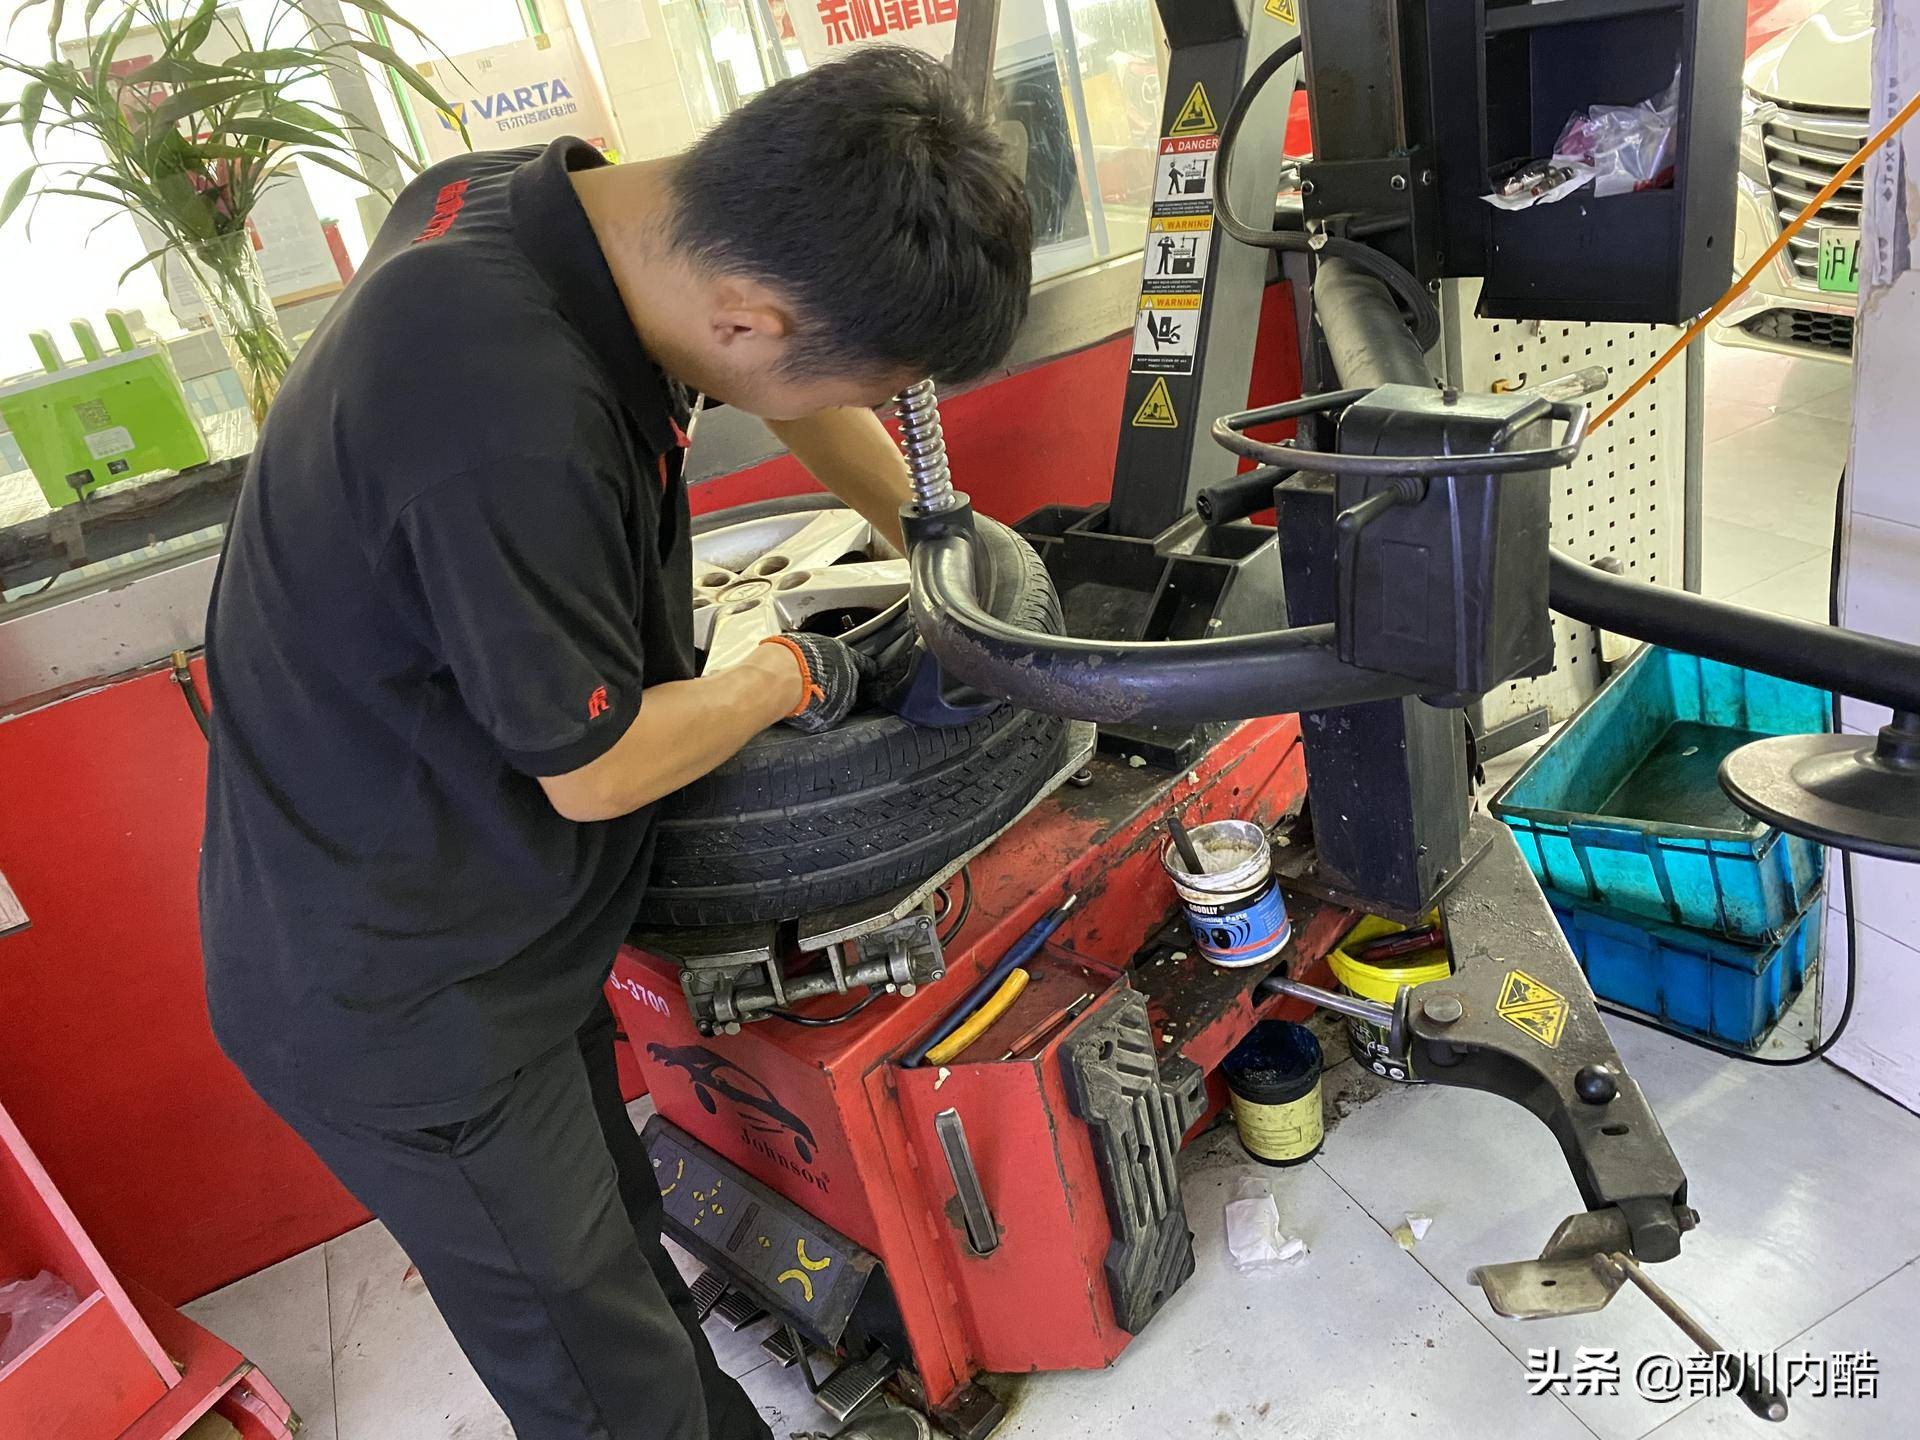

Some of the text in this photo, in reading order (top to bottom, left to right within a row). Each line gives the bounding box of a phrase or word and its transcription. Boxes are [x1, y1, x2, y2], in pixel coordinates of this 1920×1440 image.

[471, 79, 572, 120] VARTA
[496, 102, 577, 132] 瓦尔塔蓄电池
[1178, 138, 1219, 151] DANGER
[1167, 219, 1209, 231] WARNING
[1156, 298, 1199, 308] WARNING
[1225, 912, 1249, 923] Paste
[741, 1128, 829, 1194] Johnson
